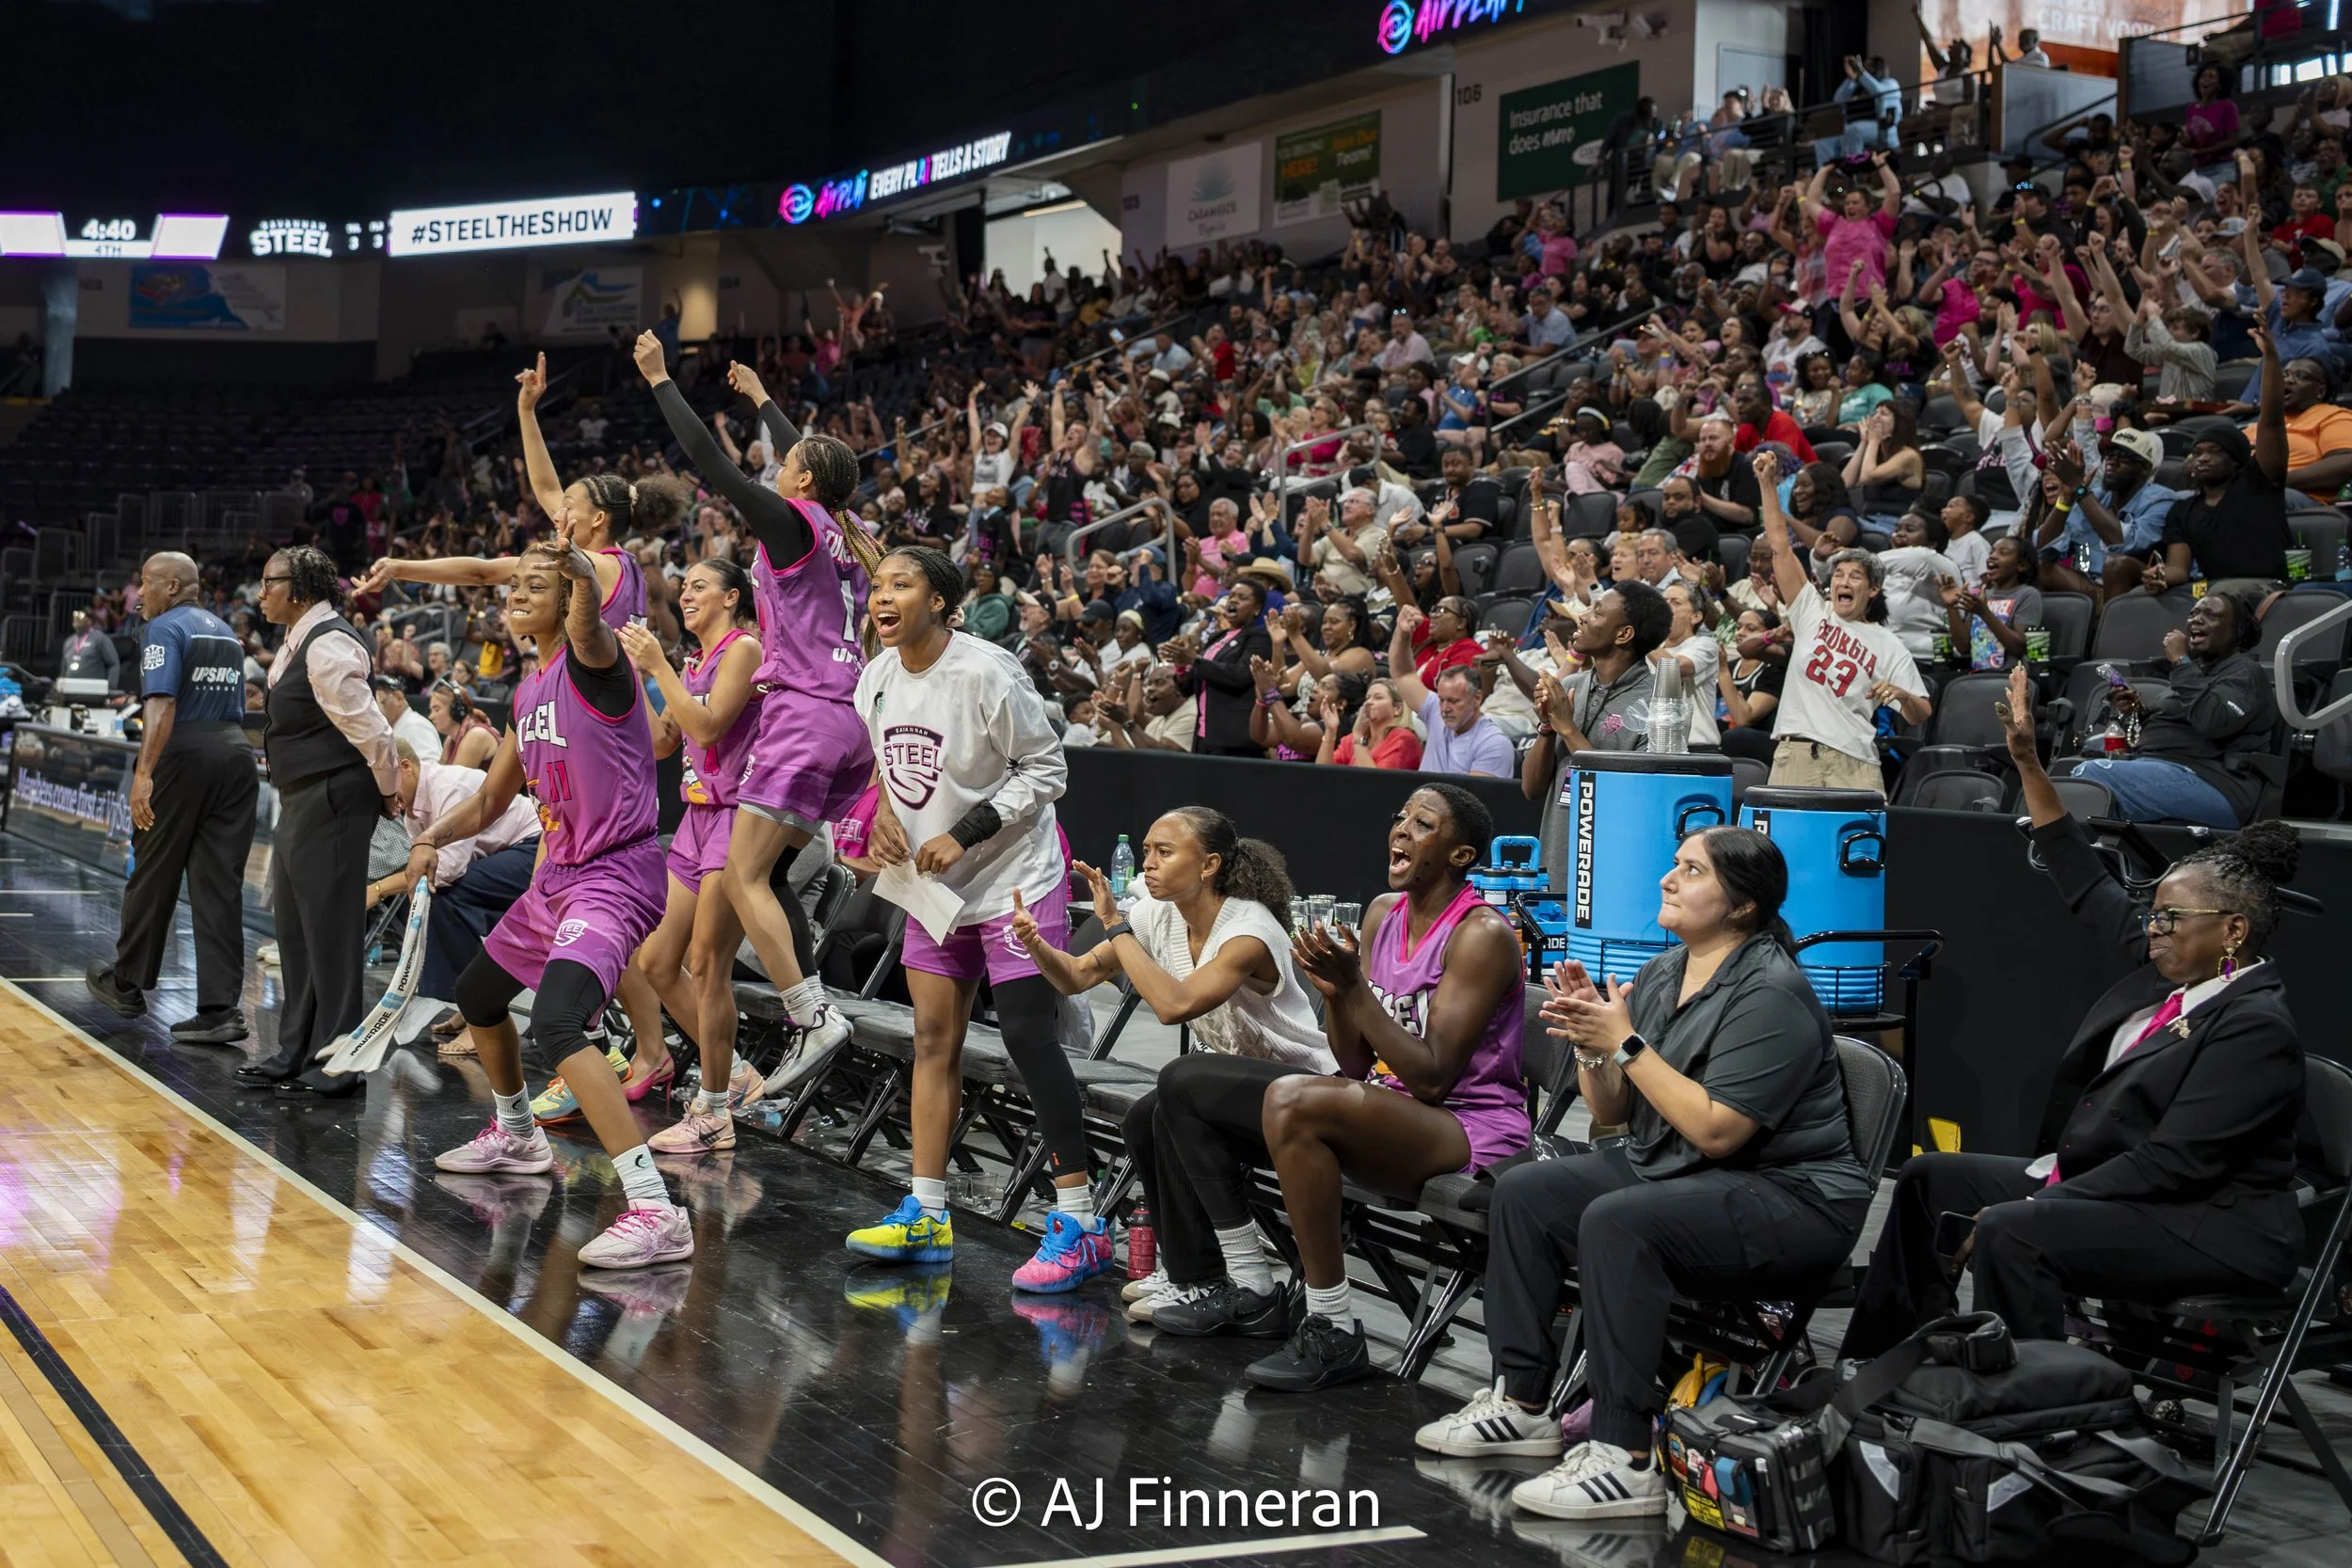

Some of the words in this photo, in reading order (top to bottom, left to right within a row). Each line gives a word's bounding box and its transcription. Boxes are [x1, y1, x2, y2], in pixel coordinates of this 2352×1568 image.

[2039, 8, 2099, 37] CRAFT
[1457, 84, 1482, 106] 106
[1510, 101, 1572, 129] Insurance
[1575, 90, 1603, 116] that
[1509, 134, 1541, 155] does
[1542, 126, 1576, 149] more
[868, 165, 905, 200] EVERY
[930, 145, 964, 182] TELLS
[961, 143, 974, 172] A
[972, 131, 1011, 169] STORY
[82, 218, 136, 240] 4:40
[249, 229, 332, 258] STEEL
[412, 208, 612, 244] #STEELTHESHOW
[95, 244, 121, 257] 4TH
[192, 667, 241, 684] UPSHOT
[1805, 644, 1858, 697] 23
[516, 700, 568, 752] TEEL
[883, 741, 944, 773] STEEL
[17, 766, 54, 808] Members
[53, 783, 77, 815] come
[76, 782, 97, 821] first
[546, 759, 572, 802] 11
[834, 818, 863, 843] TEEL
[1577, 782, 1593, 922] POWERADE
[398, 941, 418, 991] POWER
[1369, 979, 1429, 1038] EEL
